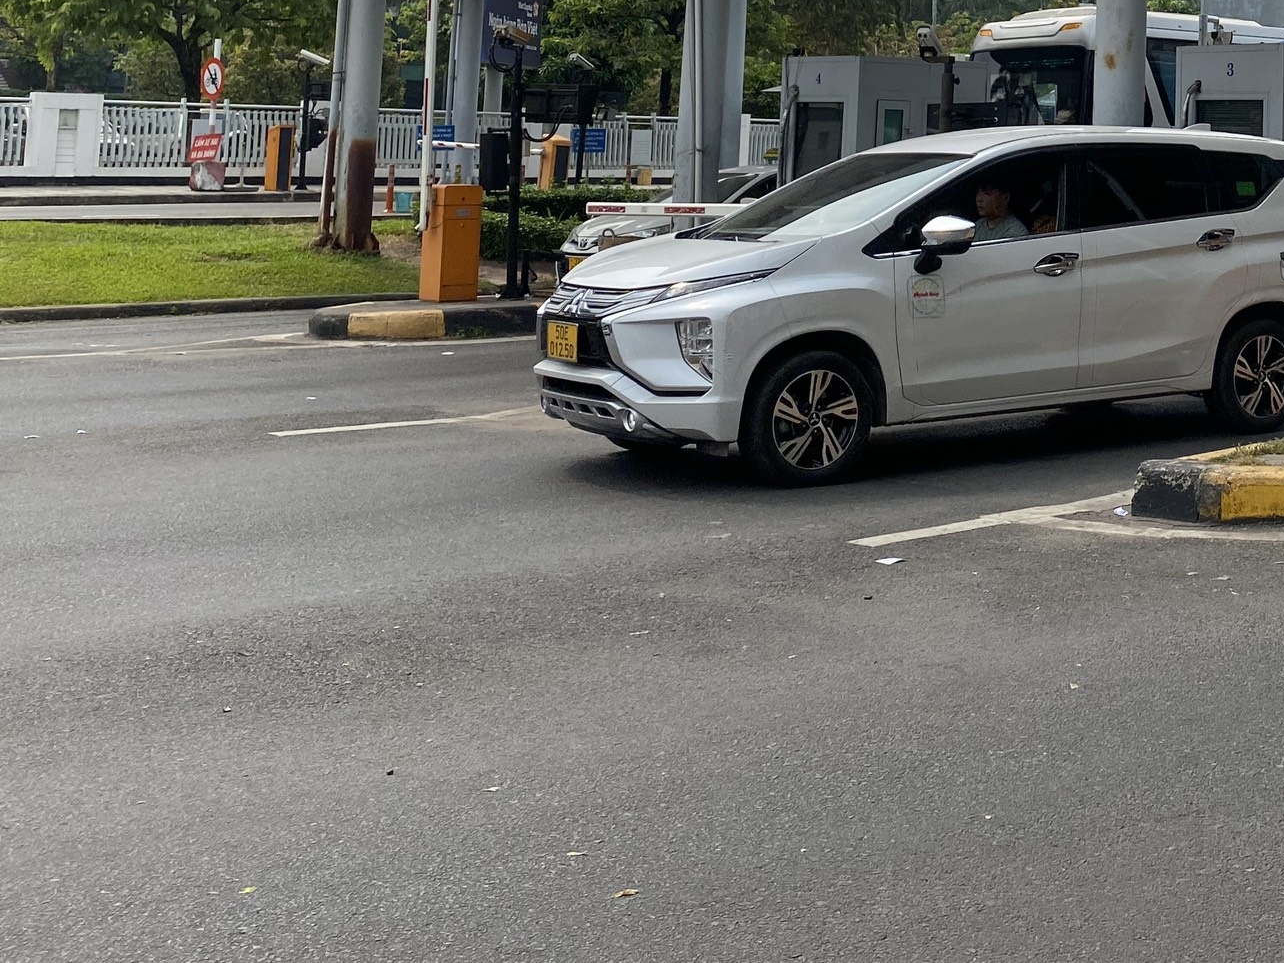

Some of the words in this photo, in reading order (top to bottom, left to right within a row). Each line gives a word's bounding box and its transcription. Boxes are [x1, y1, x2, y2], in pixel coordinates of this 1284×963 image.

[1226, 62, 1234, 77] 3
[815, 72, 821, 85] 4
[555, 324, 569, 341] 50E
